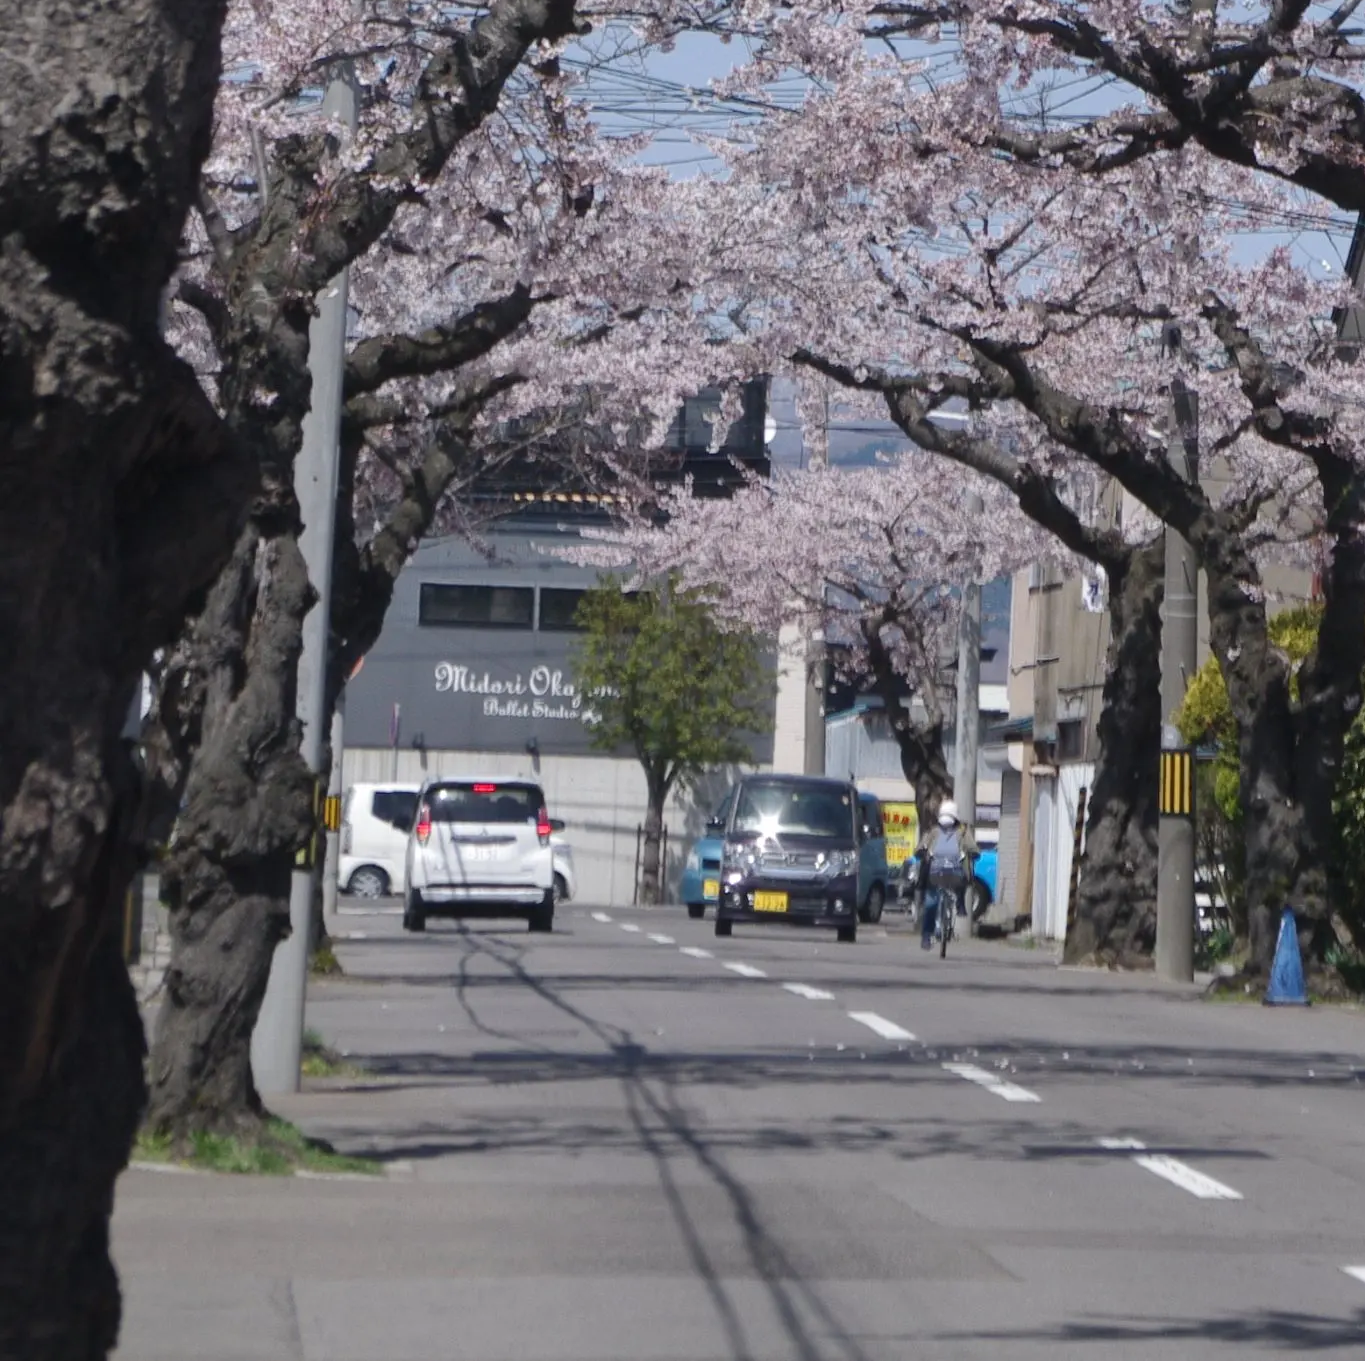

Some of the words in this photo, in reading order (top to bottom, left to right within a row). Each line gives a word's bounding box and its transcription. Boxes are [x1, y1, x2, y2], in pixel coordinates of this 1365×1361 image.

[434, 660, 527, 694] Midori
[484, 697, 529, 717] Ballet
[532, 698, 579, 720] Studio
